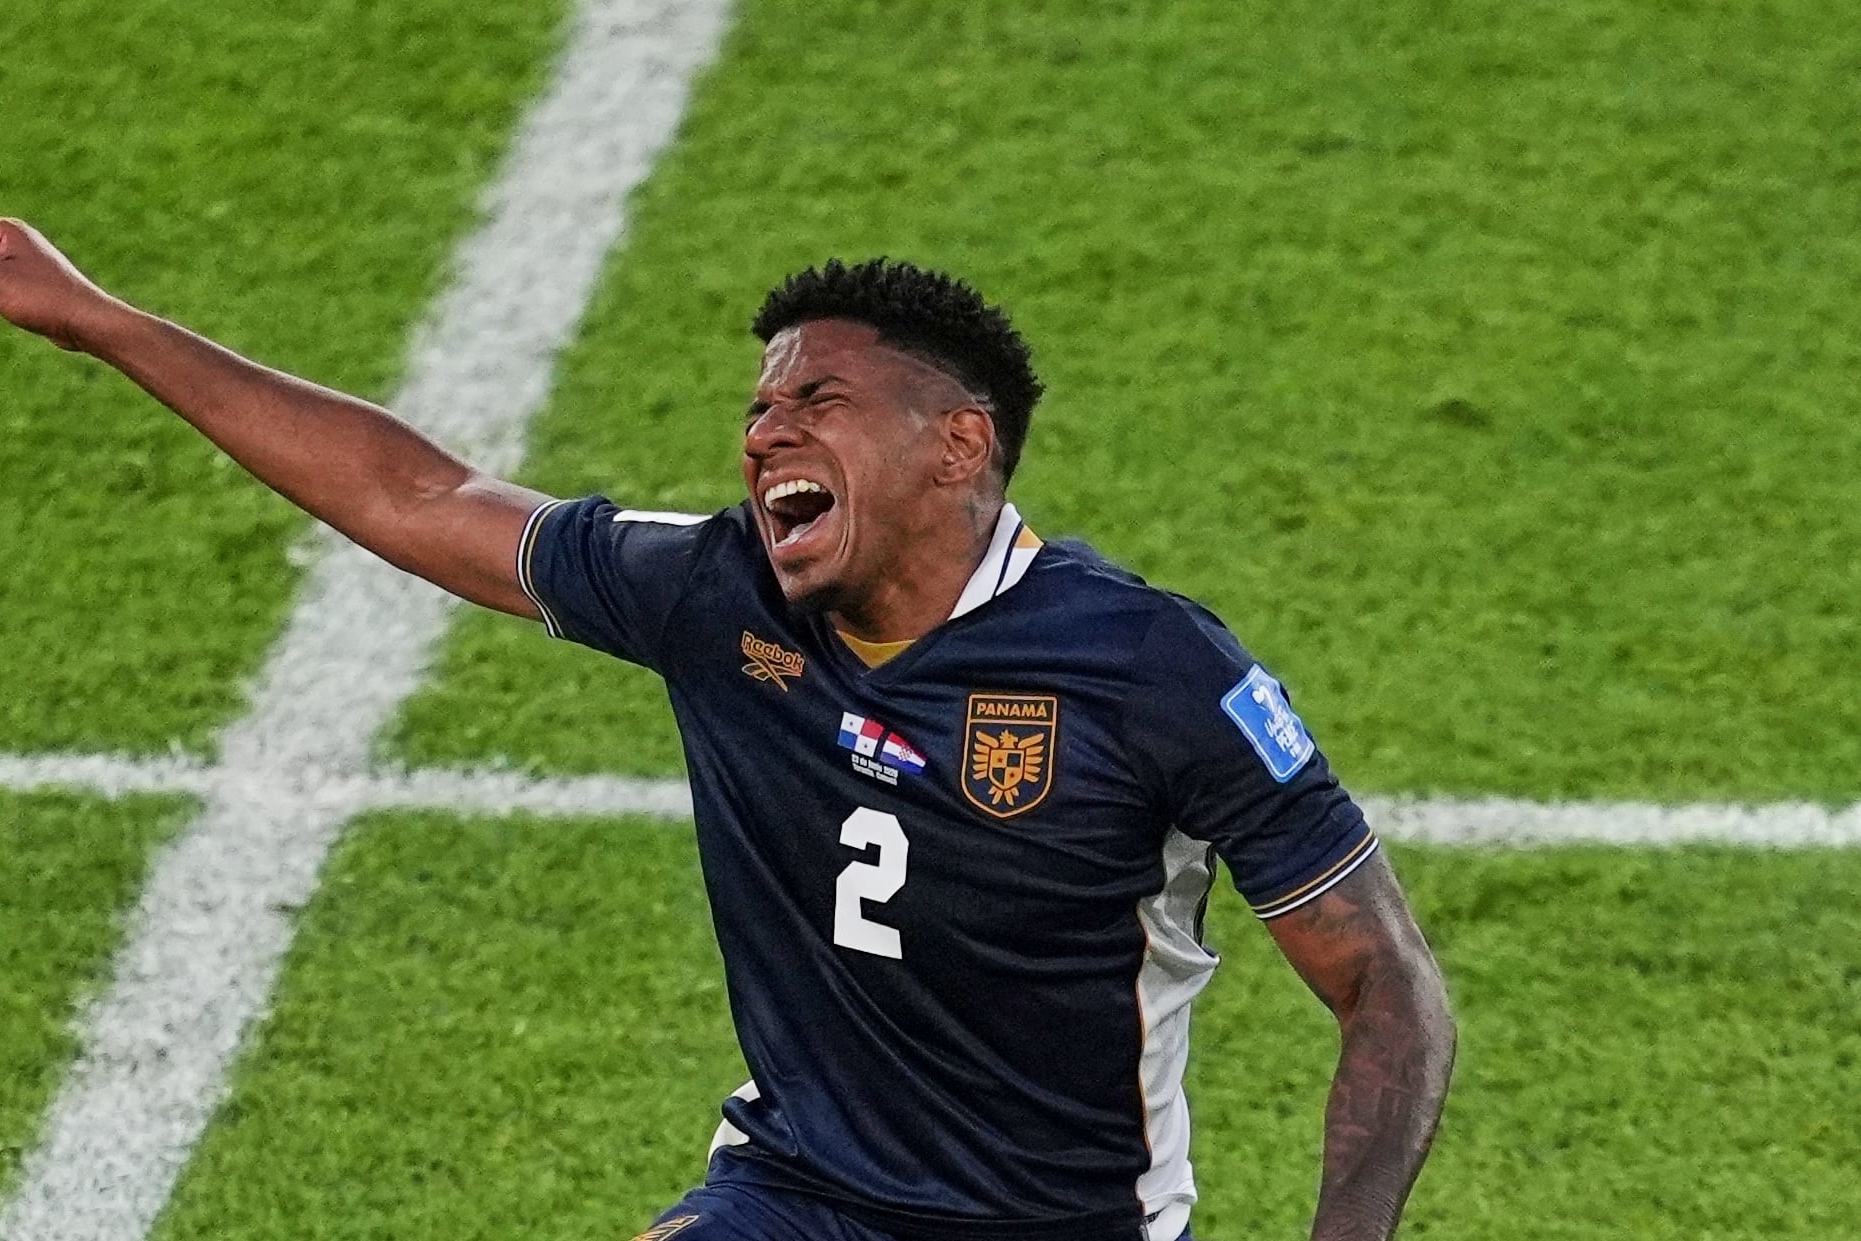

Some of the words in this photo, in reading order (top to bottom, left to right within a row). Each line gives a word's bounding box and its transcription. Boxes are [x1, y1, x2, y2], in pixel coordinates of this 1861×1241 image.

[741, 631, 804, 673] Reebok
[976, 702, 1047, 718] PANAMÁ
[833, 806, 909, 960] 2
